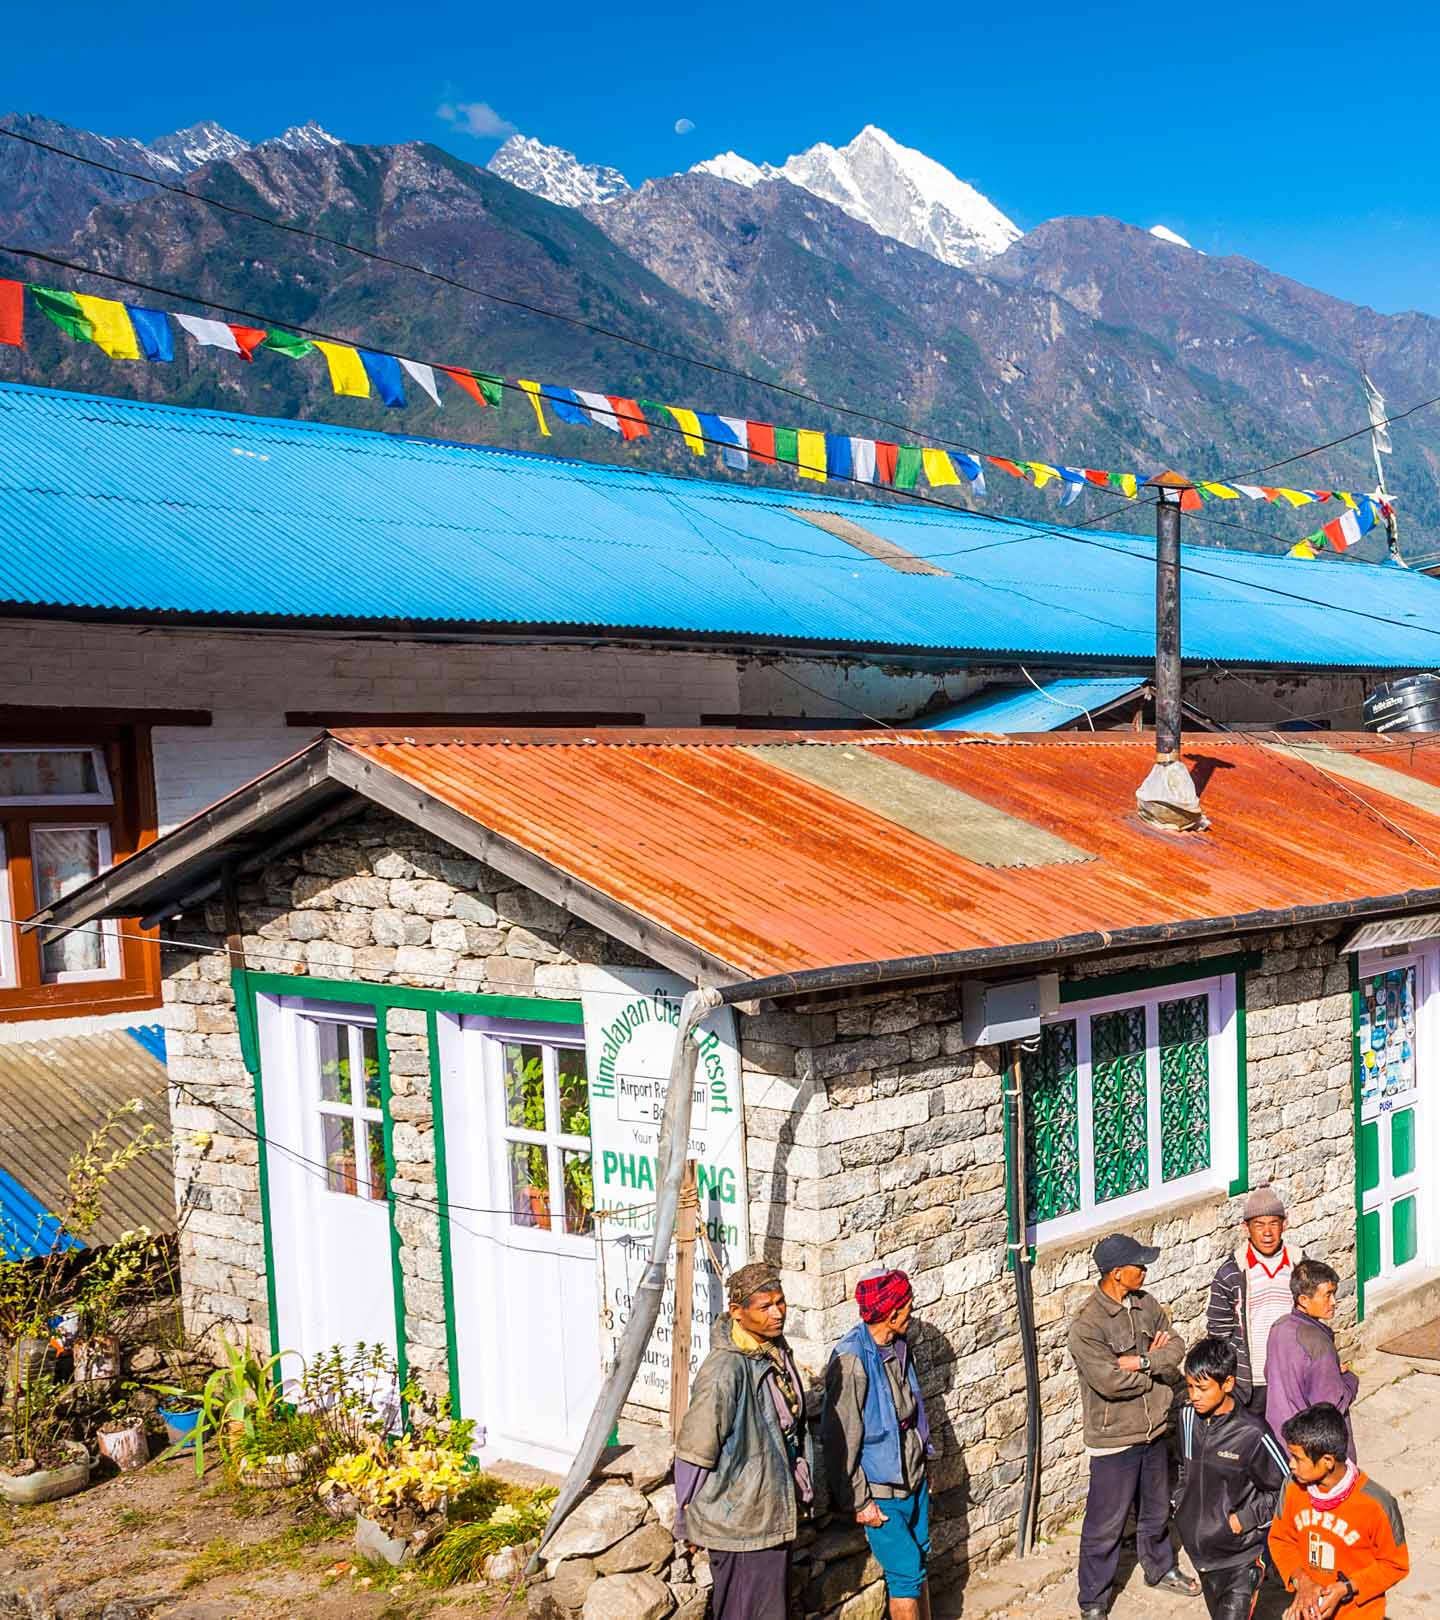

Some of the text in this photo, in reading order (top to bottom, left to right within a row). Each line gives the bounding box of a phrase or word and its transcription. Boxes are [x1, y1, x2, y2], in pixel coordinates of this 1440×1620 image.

[591, 998, 651, 1099] Himalayan
[699, 1030, 733, 1114] Resort
[619, 1077, 653, 1101] Airport
[1379, 1099, 1393, 1112] PUSH
